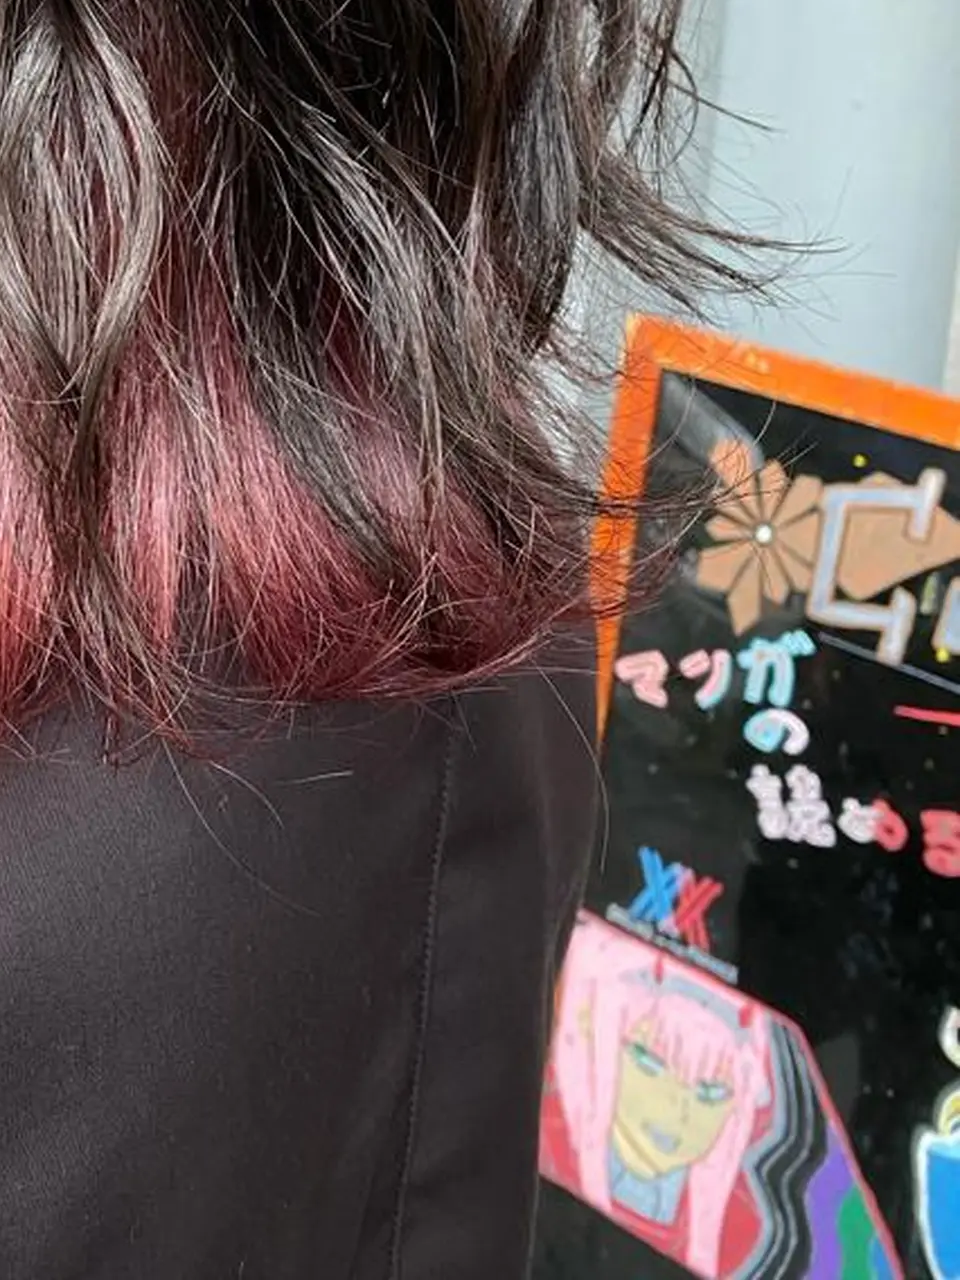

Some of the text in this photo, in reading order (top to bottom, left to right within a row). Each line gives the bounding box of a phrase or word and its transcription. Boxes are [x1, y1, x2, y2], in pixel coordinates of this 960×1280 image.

[615, 629, 816, 708] マンガ
[743, 708, 810, 755] の
